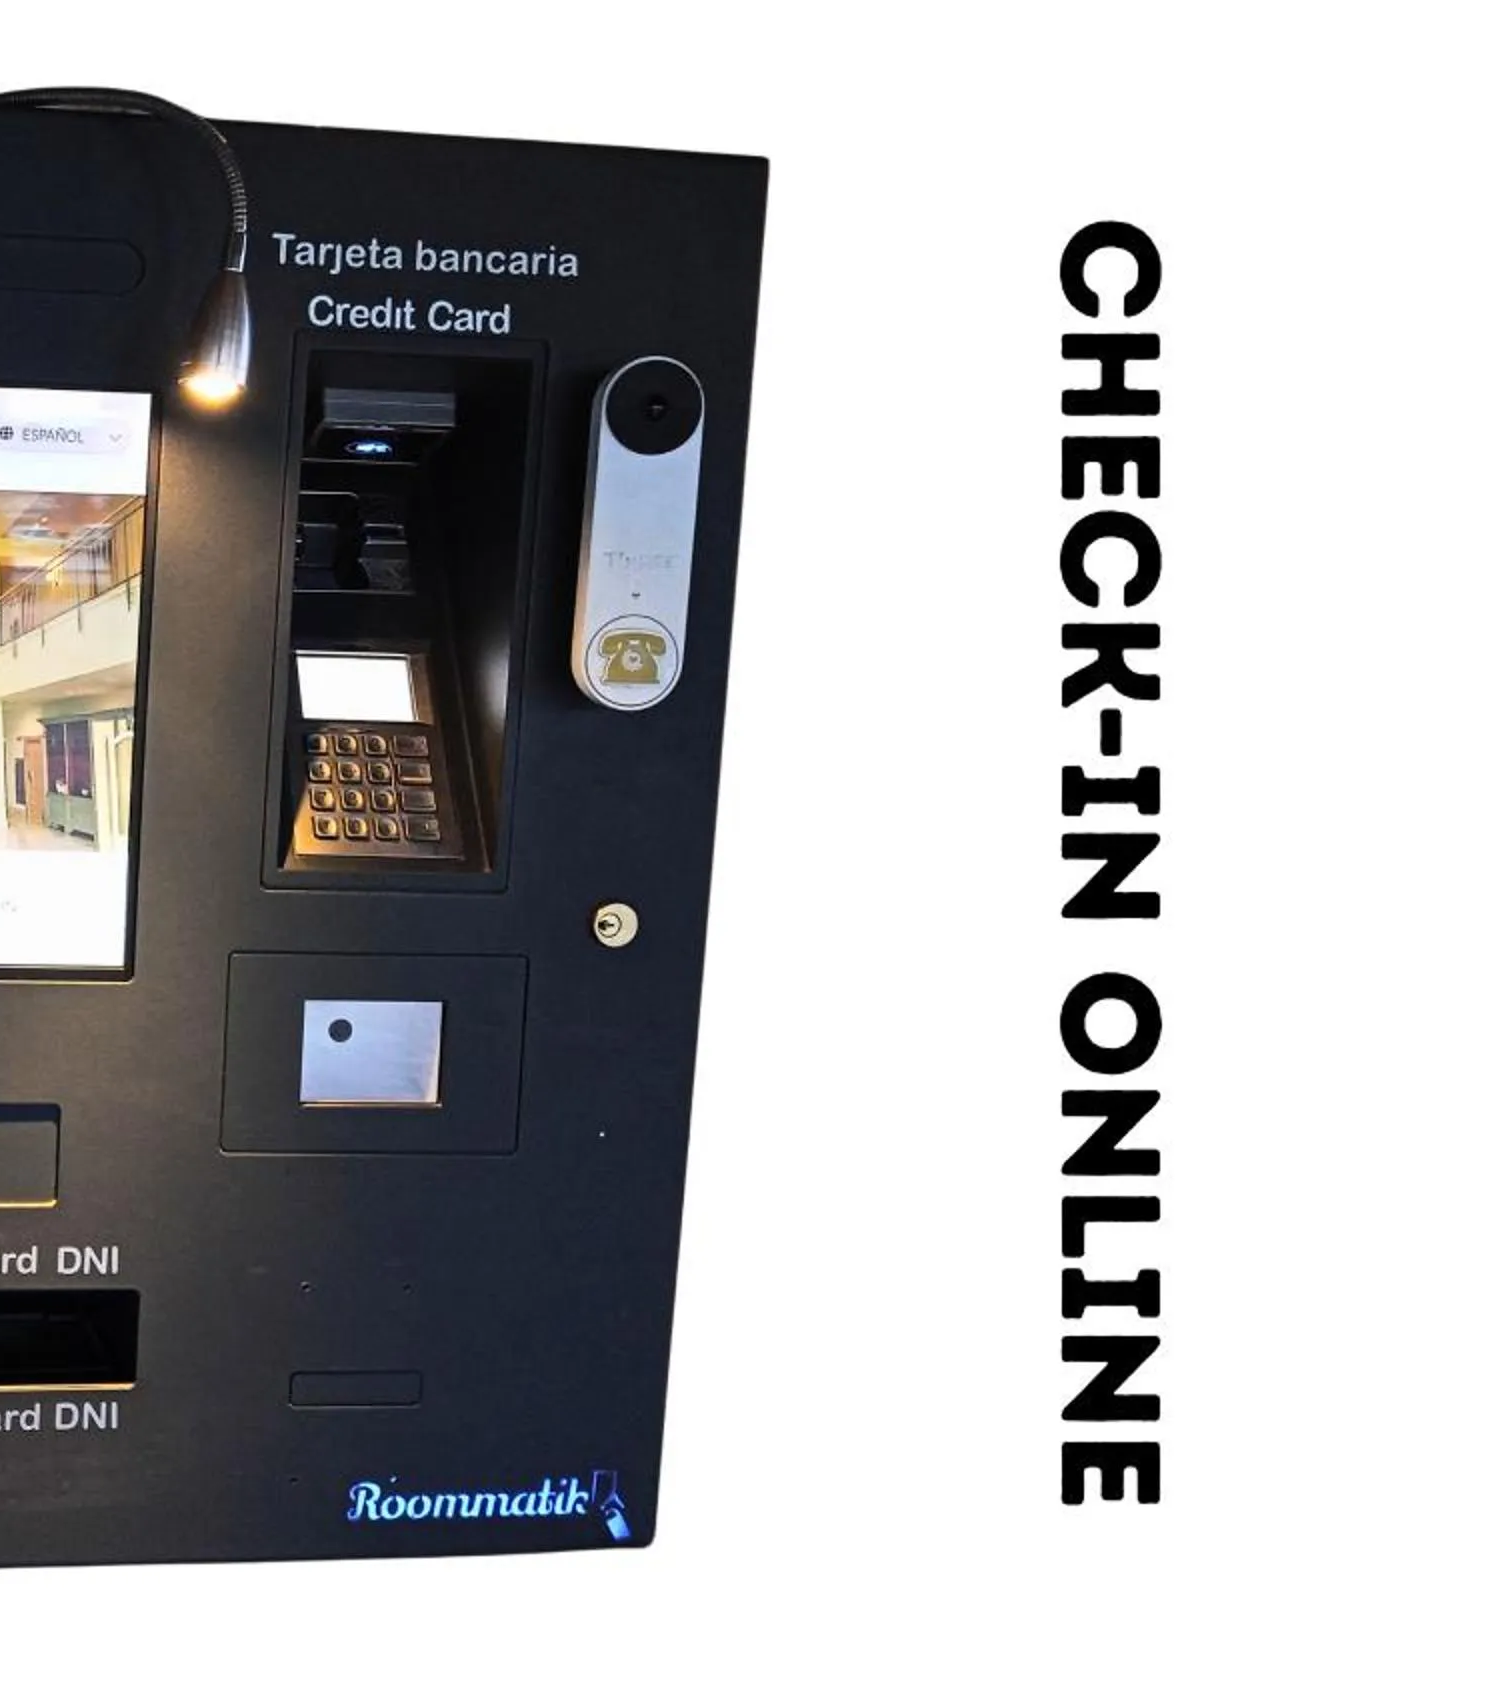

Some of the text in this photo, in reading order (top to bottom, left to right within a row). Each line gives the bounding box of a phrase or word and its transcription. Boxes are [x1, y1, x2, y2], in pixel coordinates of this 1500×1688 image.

[272, 232, 578, 277] Tarjeta bancaria
[308, 295, 511, 335] Credit Card
[21, 423, 84, 445] ESPAÑOL
[57, 1245, 119, 1275] DNI
[55, 1401, 118, 1430] DNI
[347, 1477, 589, 1521] Roommatik
